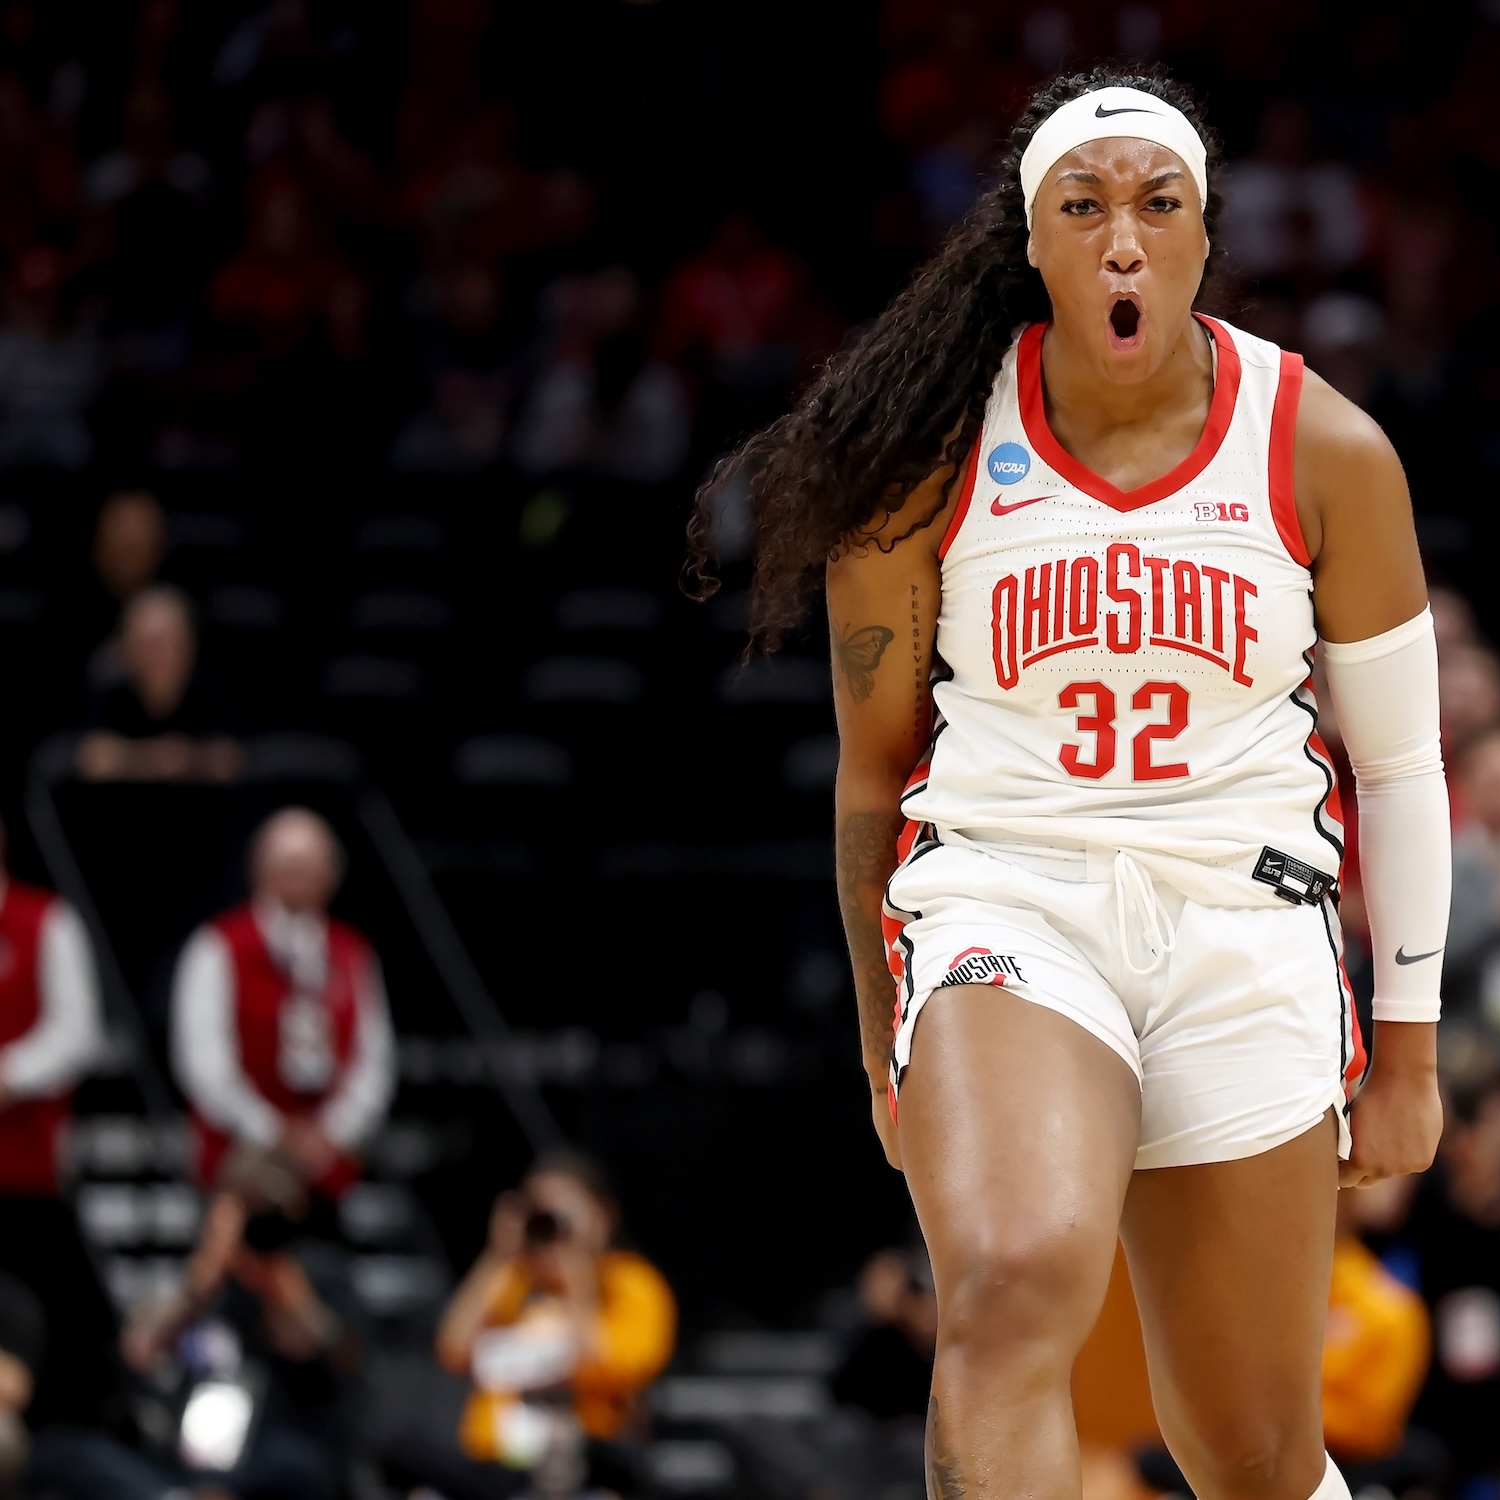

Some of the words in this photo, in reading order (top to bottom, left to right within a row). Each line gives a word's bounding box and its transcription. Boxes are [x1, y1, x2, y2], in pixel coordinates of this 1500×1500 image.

[993, 461, 1026, 475] NCAA
[1194, 502, 1249, 522] B1G
[1057, 679, 1191, 783] 32
